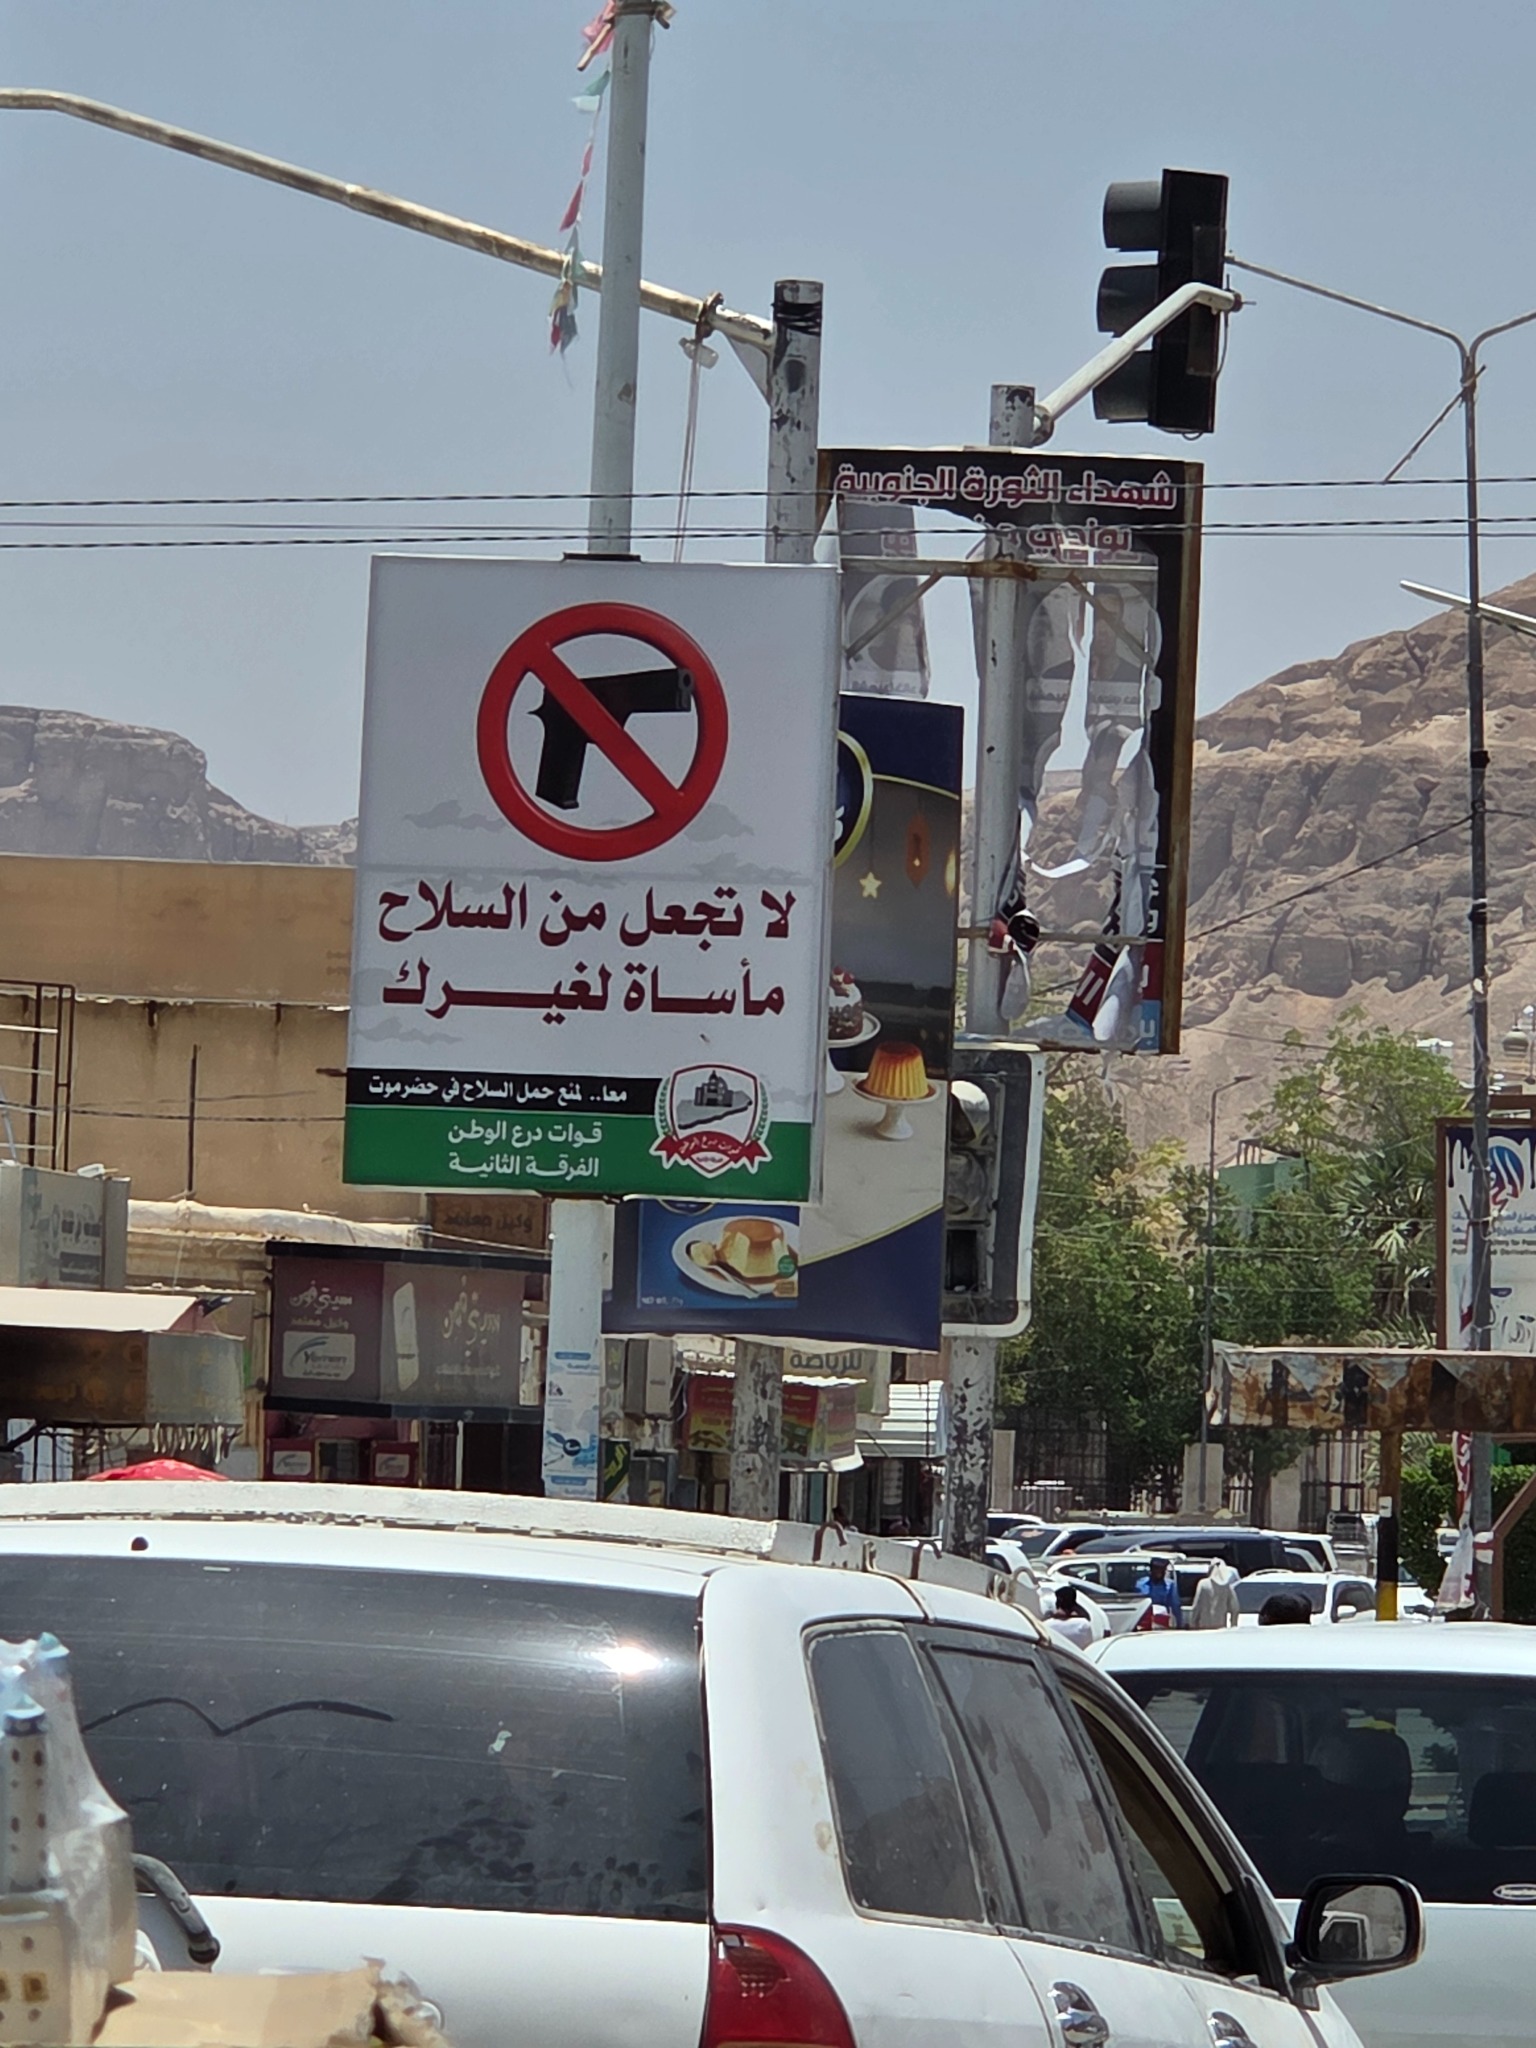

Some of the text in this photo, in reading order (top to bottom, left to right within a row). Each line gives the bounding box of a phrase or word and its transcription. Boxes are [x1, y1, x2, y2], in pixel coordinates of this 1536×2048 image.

[834, 463, 1177, 510] شهداء الثورة الجنوبية
[378, 879, 797, 951] لا تجعل من السلاح
[622, 958, 785, 1016] مأساة
[368, 1075, 439, 1098] حضرموت
[441, 1076, 460, 1102] في
[462, 1079, 514, 1101] السلاح
[516, 1081, 555, 1103] حمل
[557, 1083, 583, 1106] لمنع
[447, 1119, 603, 1148] قوات درع الوطن
[448, 1152, 600, 1181] الفرقة الثانية
